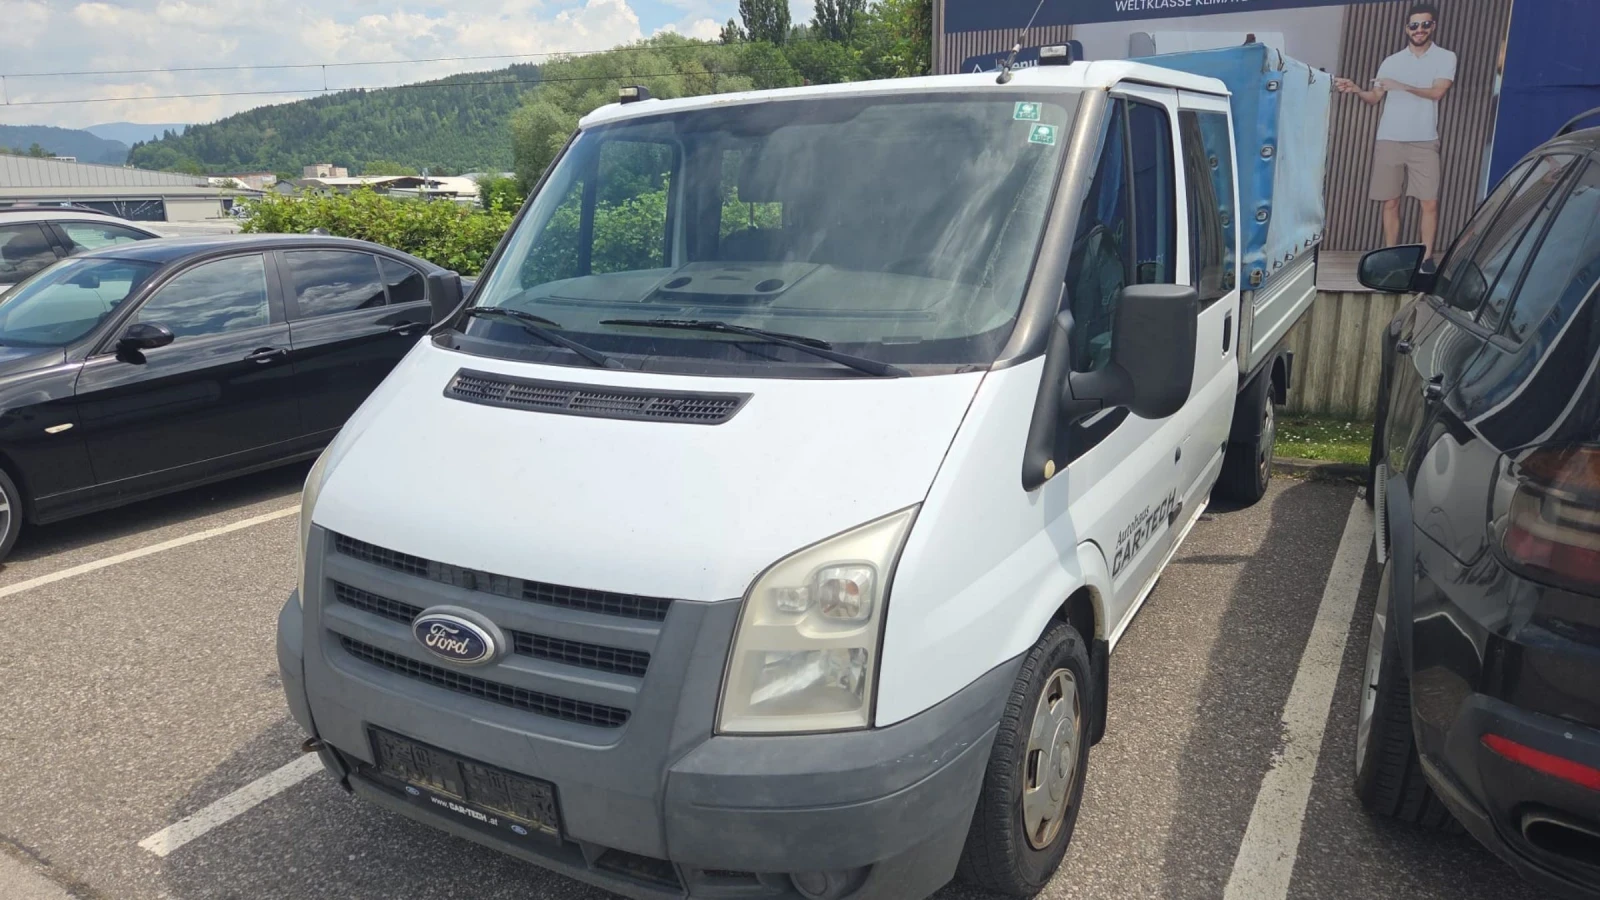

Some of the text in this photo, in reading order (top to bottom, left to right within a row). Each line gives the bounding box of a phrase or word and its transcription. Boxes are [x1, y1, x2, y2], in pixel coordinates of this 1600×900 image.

[1115, 0, 1192, 12] WELTKLASSE
[1112, 487, 1177, 578] CAR-TECH
[1116, 504, 1150, 549] Autohaus
[425, 623, 470, 655] Ford
